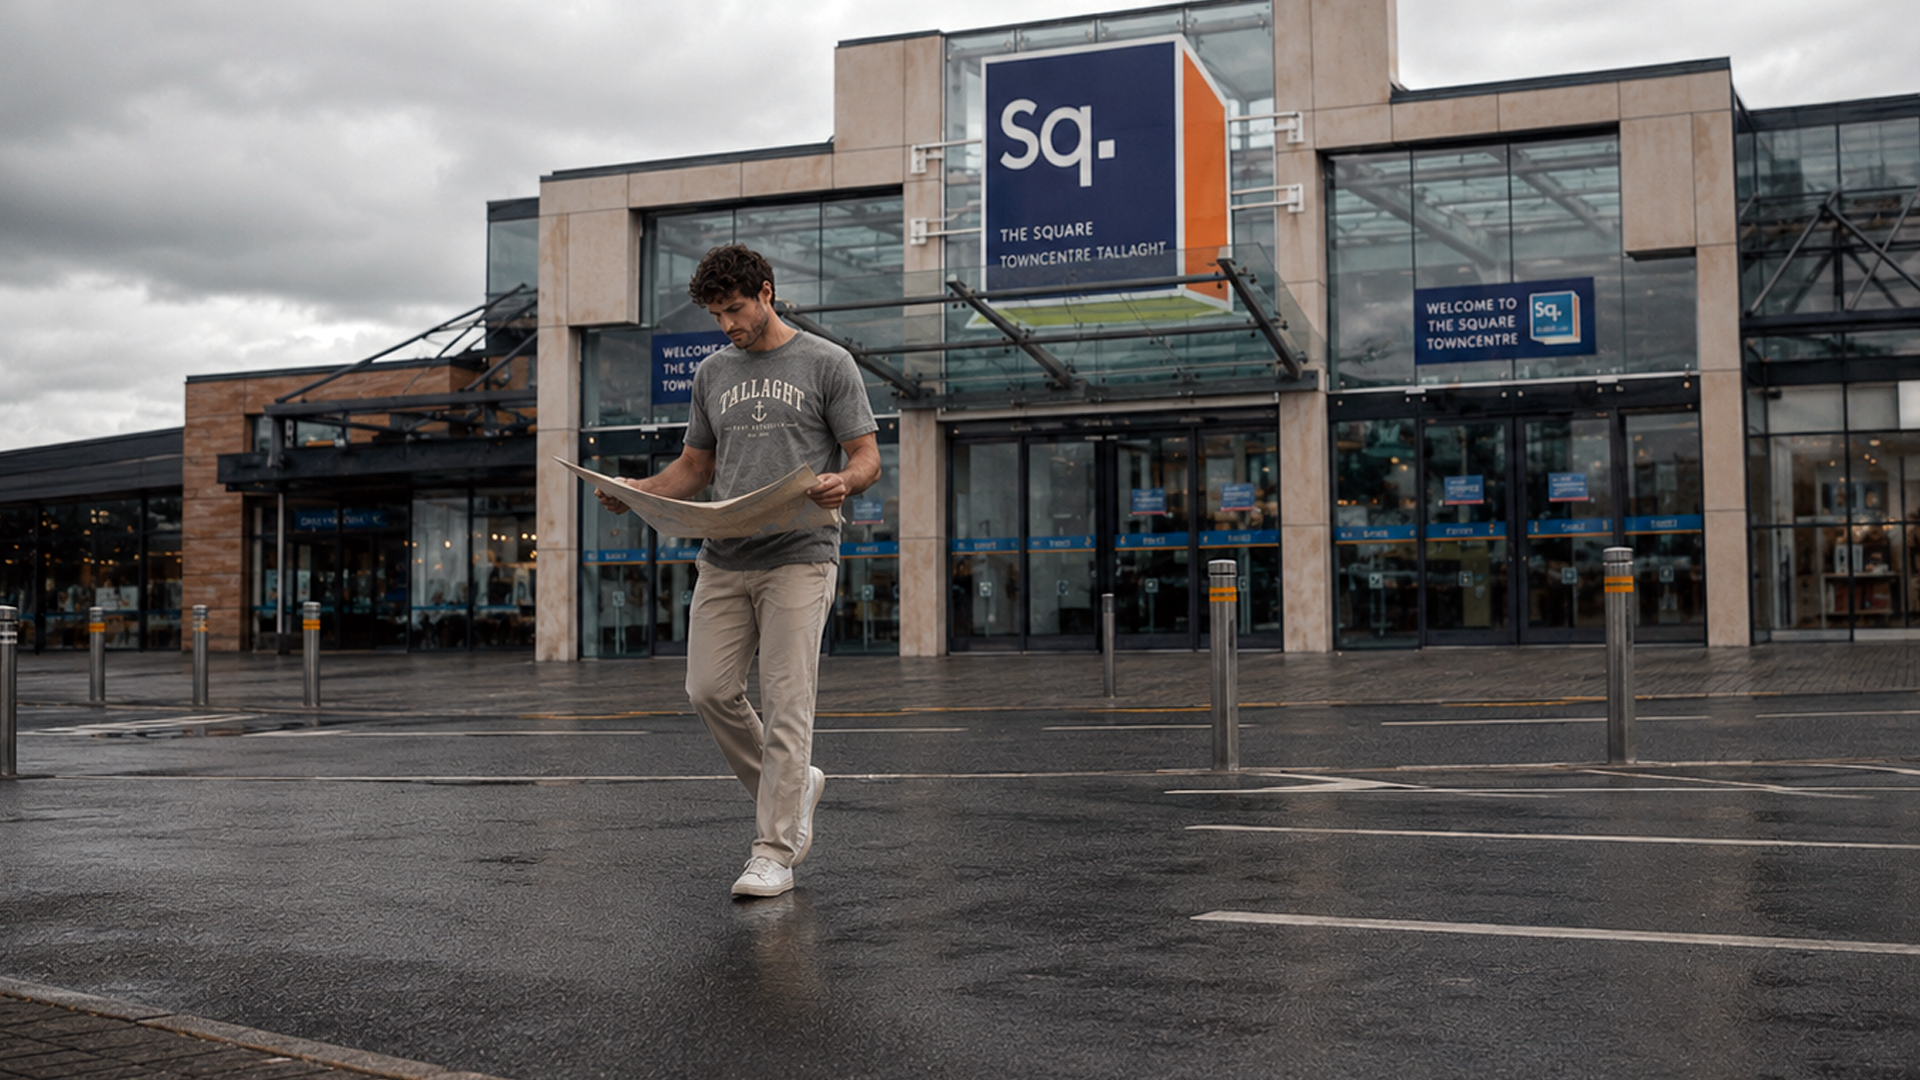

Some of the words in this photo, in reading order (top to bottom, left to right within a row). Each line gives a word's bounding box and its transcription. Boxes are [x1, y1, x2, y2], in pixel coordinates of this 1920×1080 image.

[1000, 98, 1115, 188] Sq.
[1000, 227, 1028, 243] THE
[1033, 221, 1093, 240] SQUARE
[1000, 247, 1091, 269] TOWNCENTRE
[1096, 241, 1167, 260] TALLAGHT
[1426, 299, 1495, 315] WELCOME
[1499, 297, 1518, 311] TO
[1534, 301, 1562, 322] Sq.
[1428, 319, 1454, 333] THE
[1458, 315, 1516, 331] SQUARE
[1426, 333, 1519, 351] TOWNCENTRE
[663, 362, 685, 375] THE
[719, 378, 805, 415] TALLAGHT
